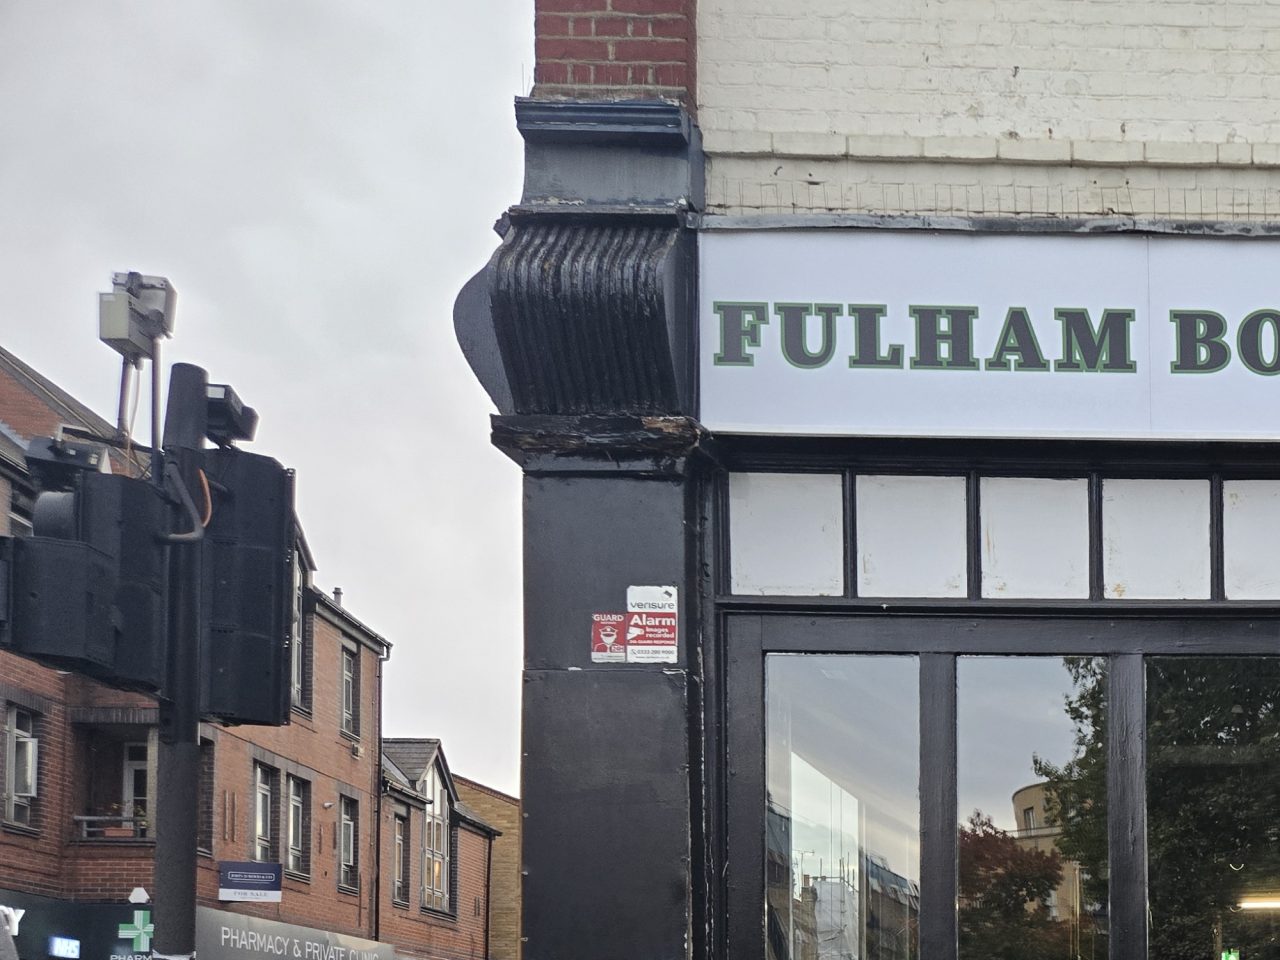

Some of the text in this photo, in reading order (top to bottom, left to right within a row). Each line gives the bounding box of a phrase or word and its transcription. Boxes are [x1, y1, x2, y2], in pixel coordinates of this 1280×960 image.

[711, 301, 1138, 373] FULHAM
[630, 614, 675, 626] Alarm
[54, 937, 80, 957] NHS
[221, 926, 290, 956] PHARMACY
[293, 939, 302, 958] &
